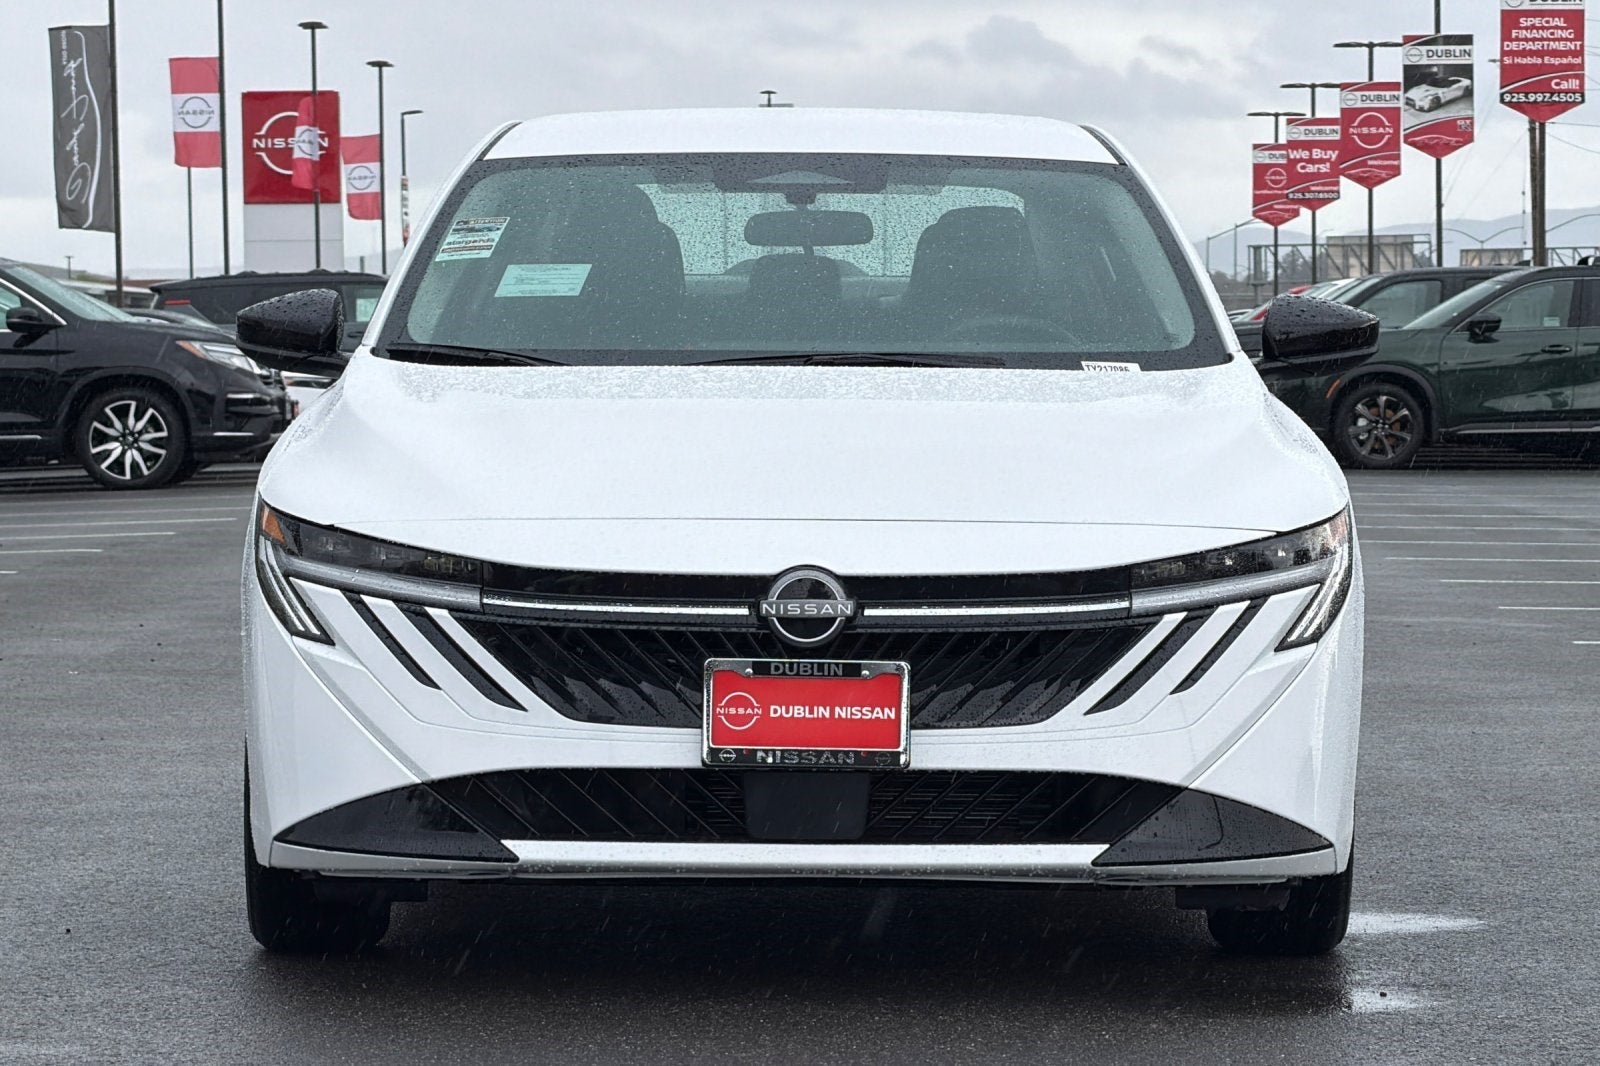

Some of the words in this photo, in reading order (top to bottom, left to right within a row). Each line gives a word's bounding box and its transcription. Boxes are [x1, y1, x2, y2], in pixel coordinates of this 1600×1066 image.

[1519, 17, 1567, 27] SPECIAL
[1511, 29, 1574, 39] FINANCING
[1503, 41, 1582, 50] DEPARTMENT
[1426, 49, 1472, 58] DUBLIN
[1514, 56, 1542, 64] Habla
[1544, 56, 1582, 66] Español
[1551, 79, 1580, 89] Call!
[1360, 94, 1400, 103] DUBLIN
[1503, 93, 1582, 102] 925.997.4505
[1303, 127, 1339, 136] DUBLIN
[252, 137, 329, 149] NISSN
[1268, 152, 1287, 160] DUB
[1288, 149, 1310, 159] We
[1312, 148, 1339, 161] Buy
[1296, 162, 1331, 173] Cars!
[762, 604, 853, 615] NISSAN
[770, 662, 843, 677] DUBLIN
[716, 707, 762, 715] NISSAN
[770, 705, 830, 719] DUBLIN
[834, 705, 896, 720] NISSAN
[756, 750, 855, 764] NISSAN
